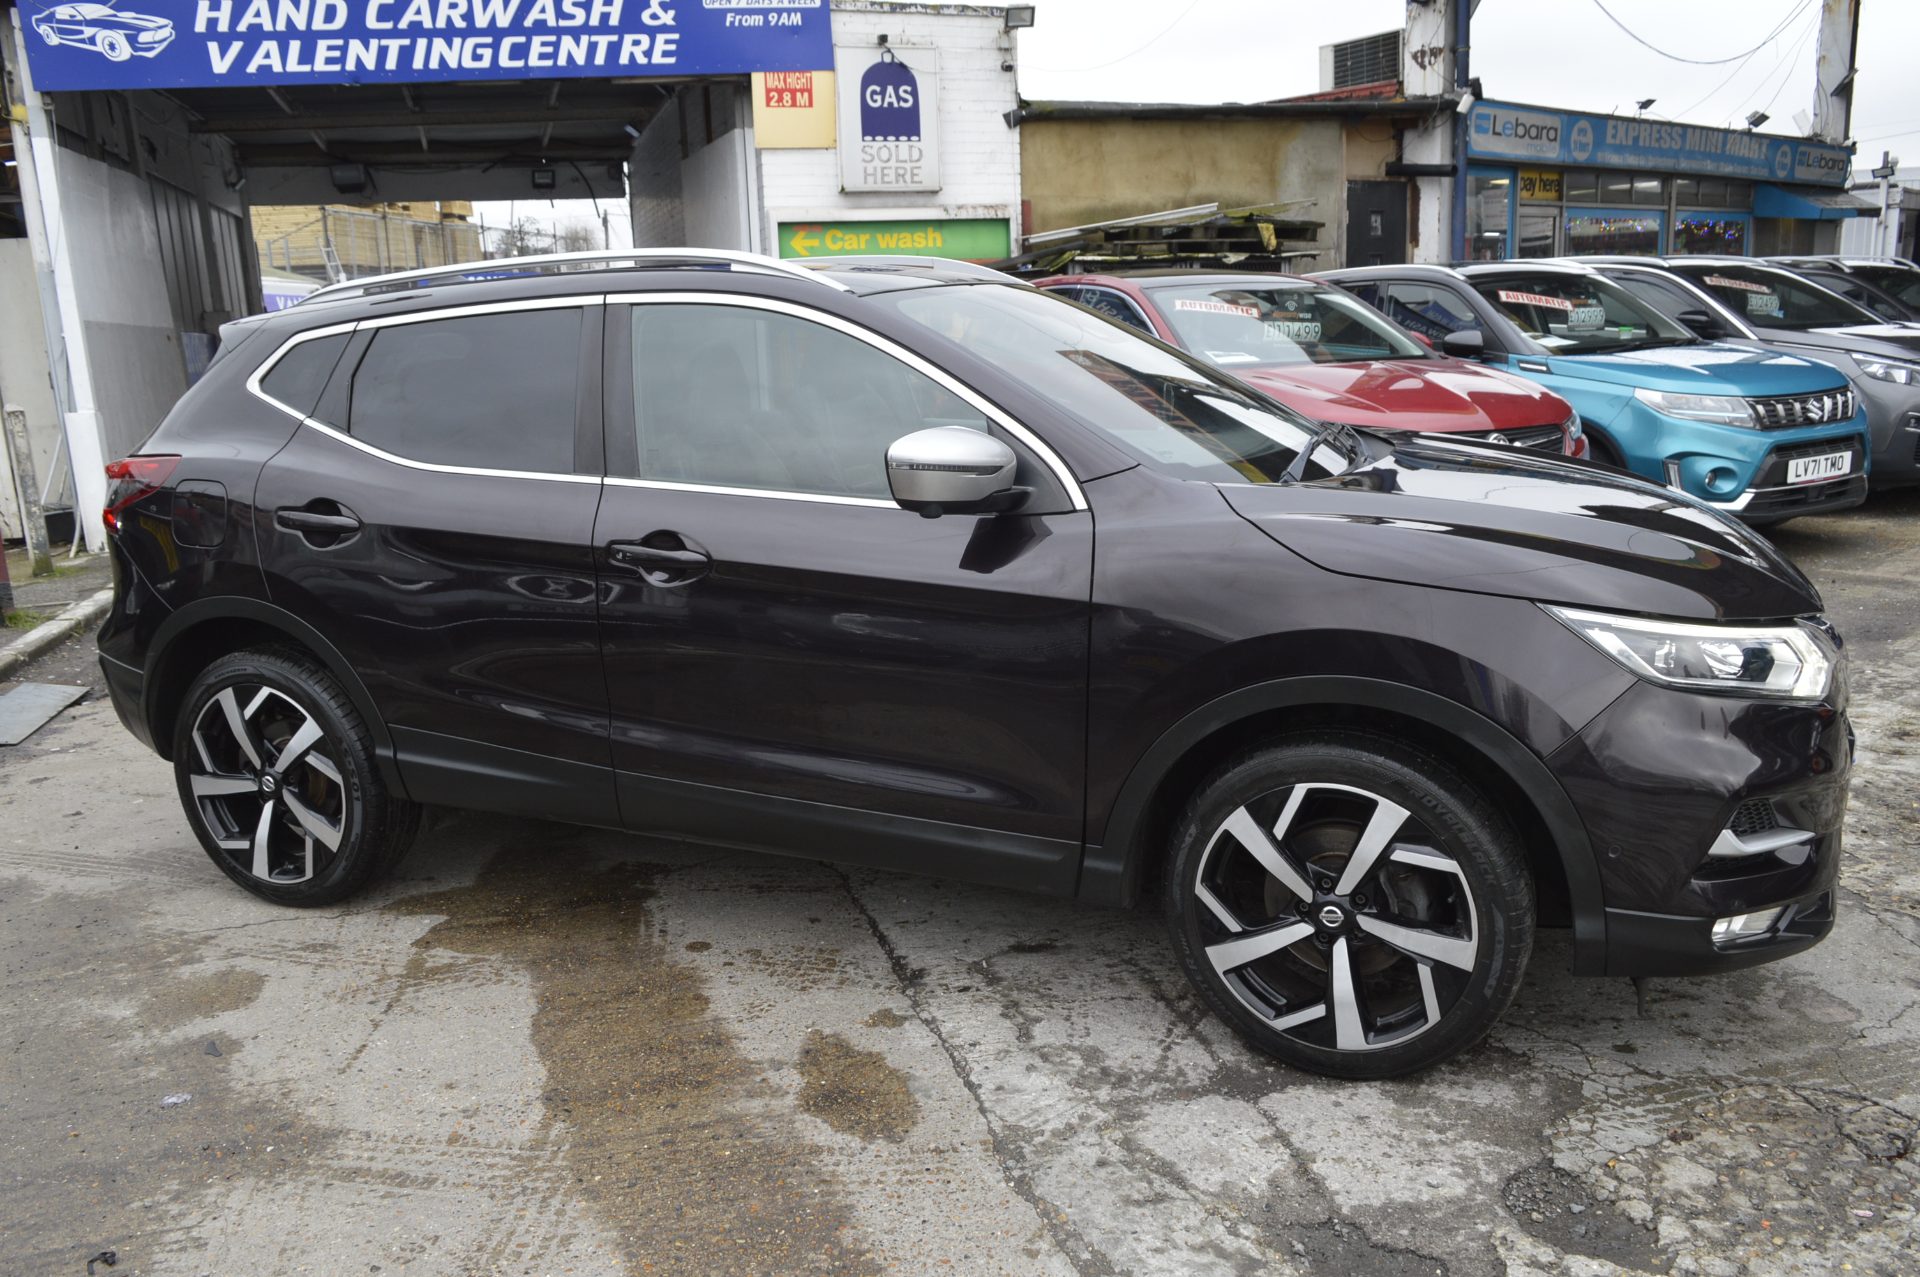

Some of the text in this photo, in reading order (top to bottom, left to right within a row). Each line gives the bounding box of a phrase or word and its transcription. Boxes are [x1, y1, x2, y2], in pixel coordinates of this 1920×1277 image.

[194, 0, 677, 32] HAND CARWASH &
[726, 12, 802, 27] From 9AM
[766, 72, 811, 89] MAX HIGHT
[769, 91, 809, 107] 2.8 M
[865, 85, 914, 108] GAS
[1491, 113, 1558, 142] Lebara
[1605, 120, 1682, 149] EXPRESS
[1686, 127, 1723, 153] MINI
[1726, 131, 1771, 159] MART
[861, 144, 923, 164] SOLD
[1806, 152, 1845, 171] Lebara
[863, 166, 923, 185] HERE
[824, 227, 943, 251] Car wash
[1180, 300, 1254, 316] AUTOMATIC
[1505, 292, 1569, 309] AUTOMATIC
[1795, 458, 1820, 478] LV71
